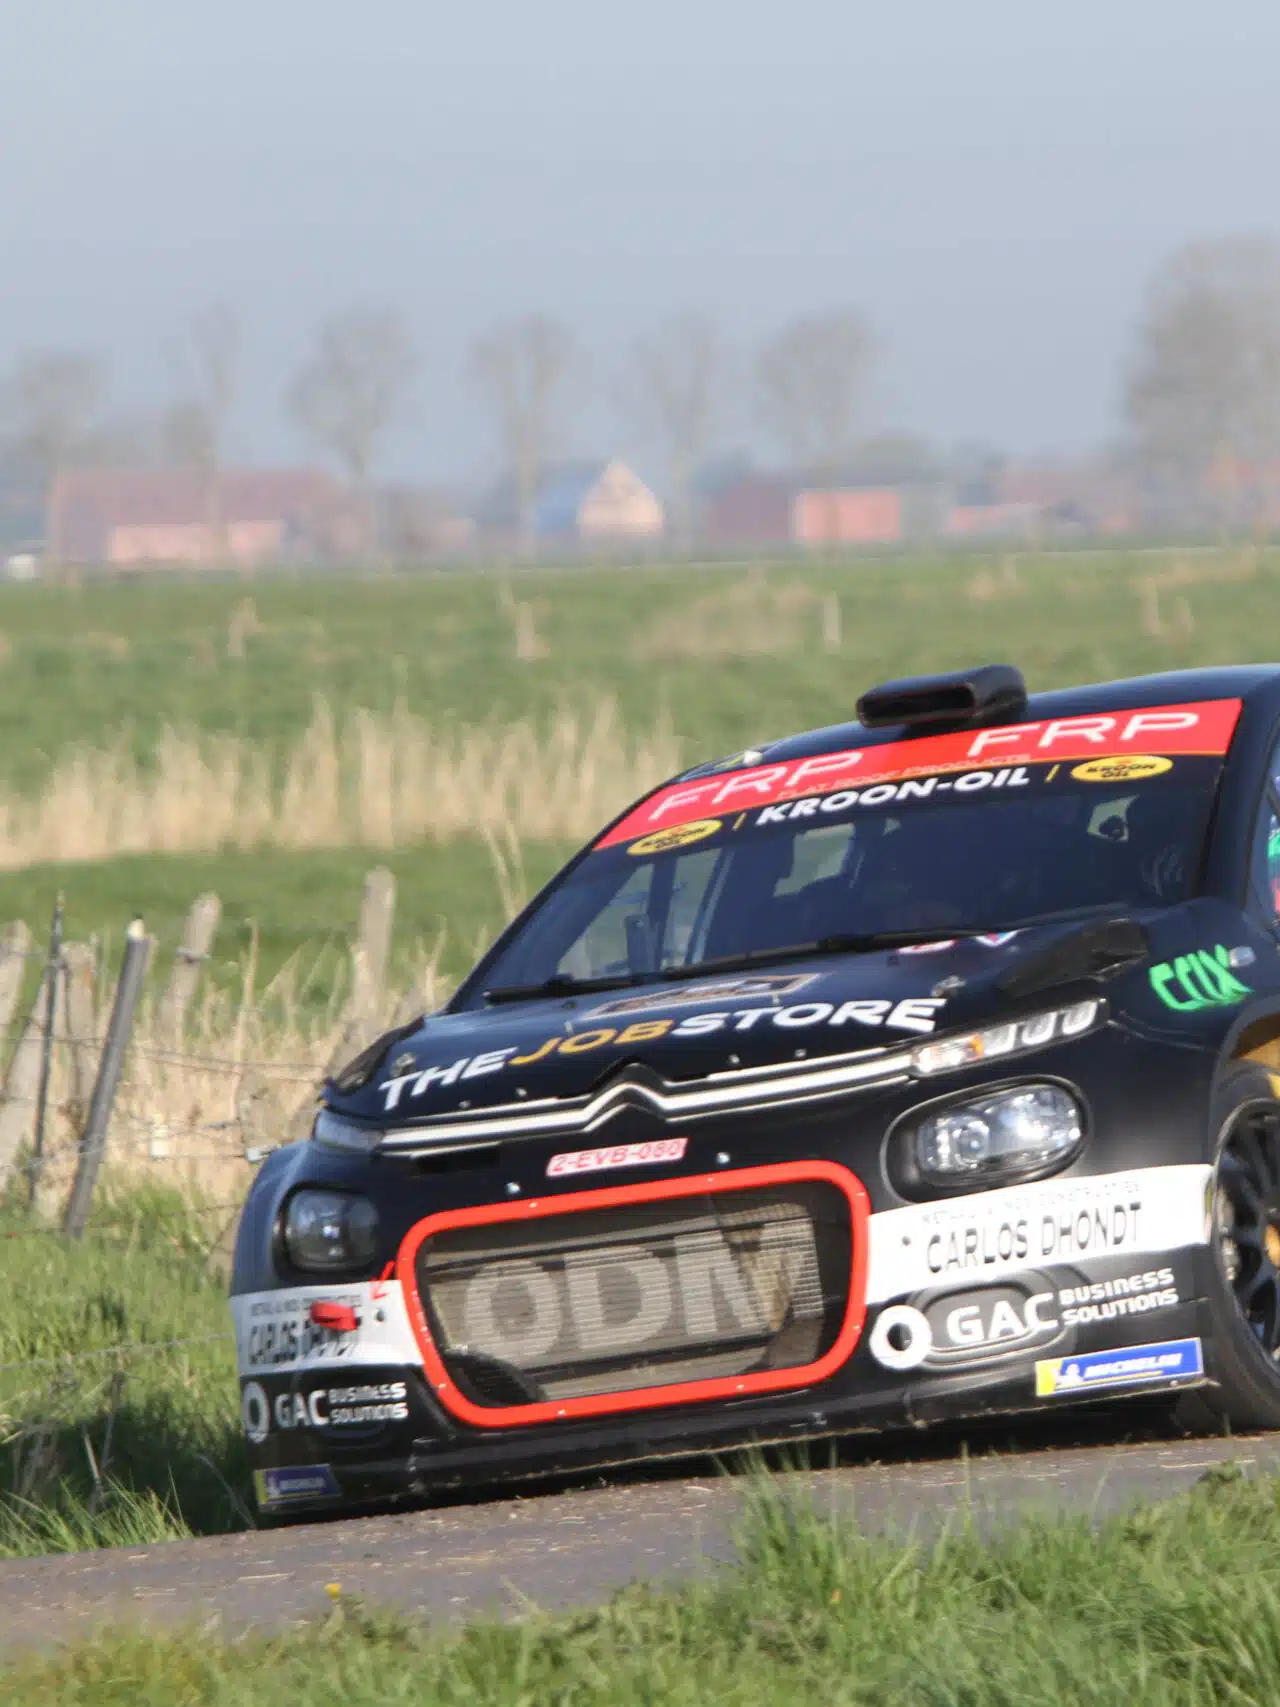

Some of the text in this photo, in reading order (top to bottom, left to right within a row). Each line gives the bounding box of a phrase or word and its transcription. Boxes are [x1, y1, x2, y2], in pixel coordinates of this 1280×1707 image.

[966, 712, 1200, 757] FRP
[648, 751, 864, 822] FRP
[755, 766, 1031, 826] KROON-OIL
[926, 1219, 1030, 1274] CARLOS
[1041, 1201, 1142, 1256] DHONDT
[466, 1216, 826, 1364] ODM
[1058, 1267, 1175, 1305] BUSINESS
[1061, 1288, 1179, 1326] SOLUTIONS
[945, 1292, 1059, 1345] GAC
[274, 1389, 330, 1428] GAC
